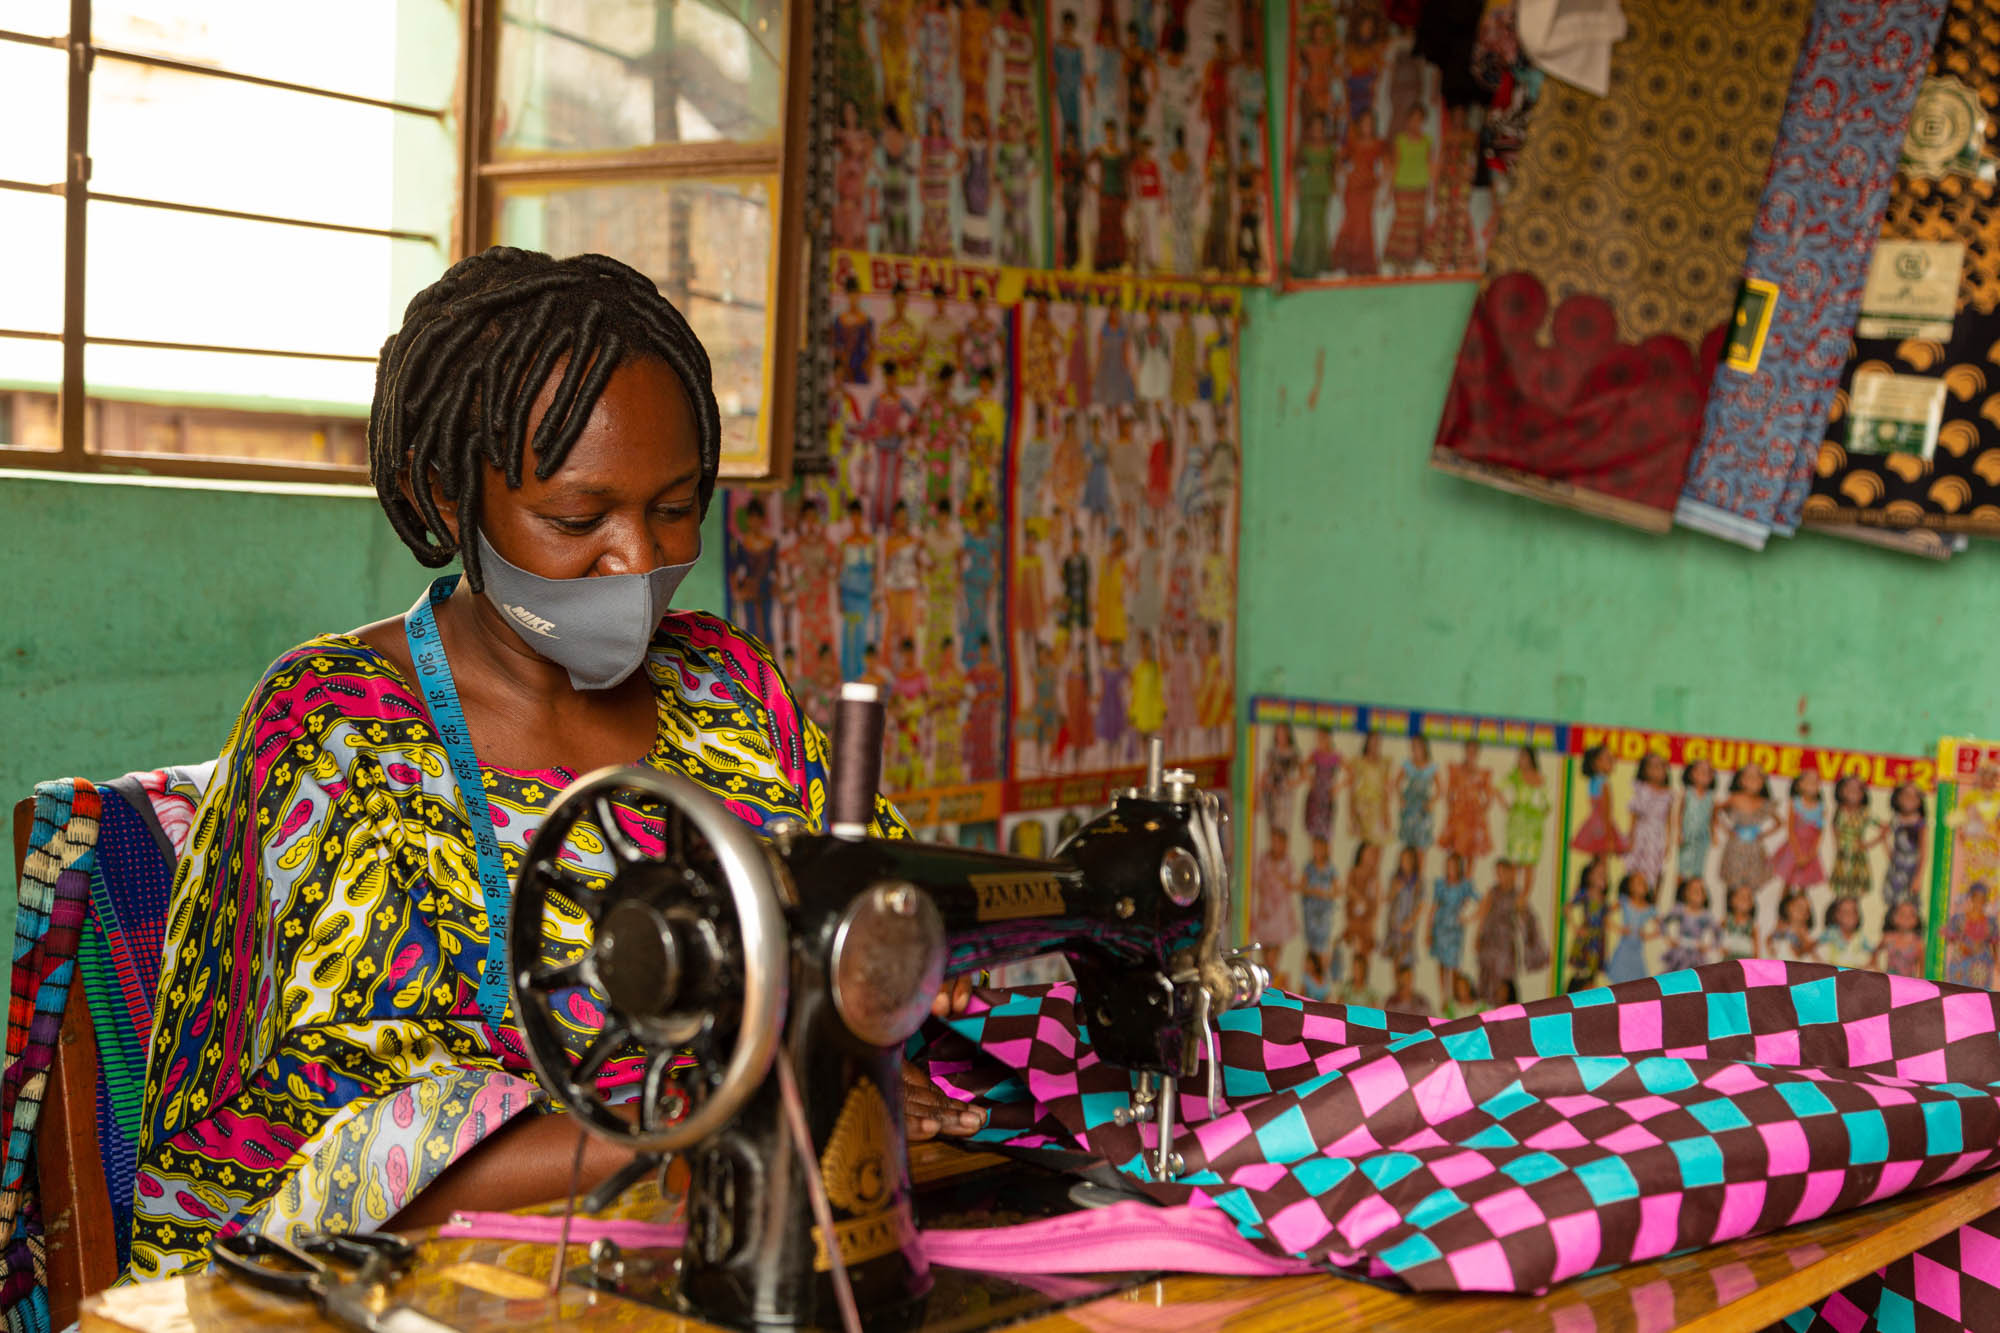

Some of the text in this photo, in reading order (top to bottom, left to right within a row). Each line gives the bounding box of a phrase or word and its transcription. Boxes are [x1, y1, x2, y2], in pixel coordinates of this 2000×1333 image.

[871, 259, 1001, 299] BEAUTY
[409, 617, 426, 639] 29
[418, 652, 437, 676] 30
[429, 690, 449, 710] 31
[441, 724, 461, 746] 32
[1583, 728, 1671, 762] KIDS
[1683, 736, 1803, 777] GUIDE
[454, 758, 473, 781] 33
[477, 832, 494, 857] 35
[484, 873, 501, 899] 36
[492, 914, 507, 941] 37
[485, 959, 504, 986] 38
